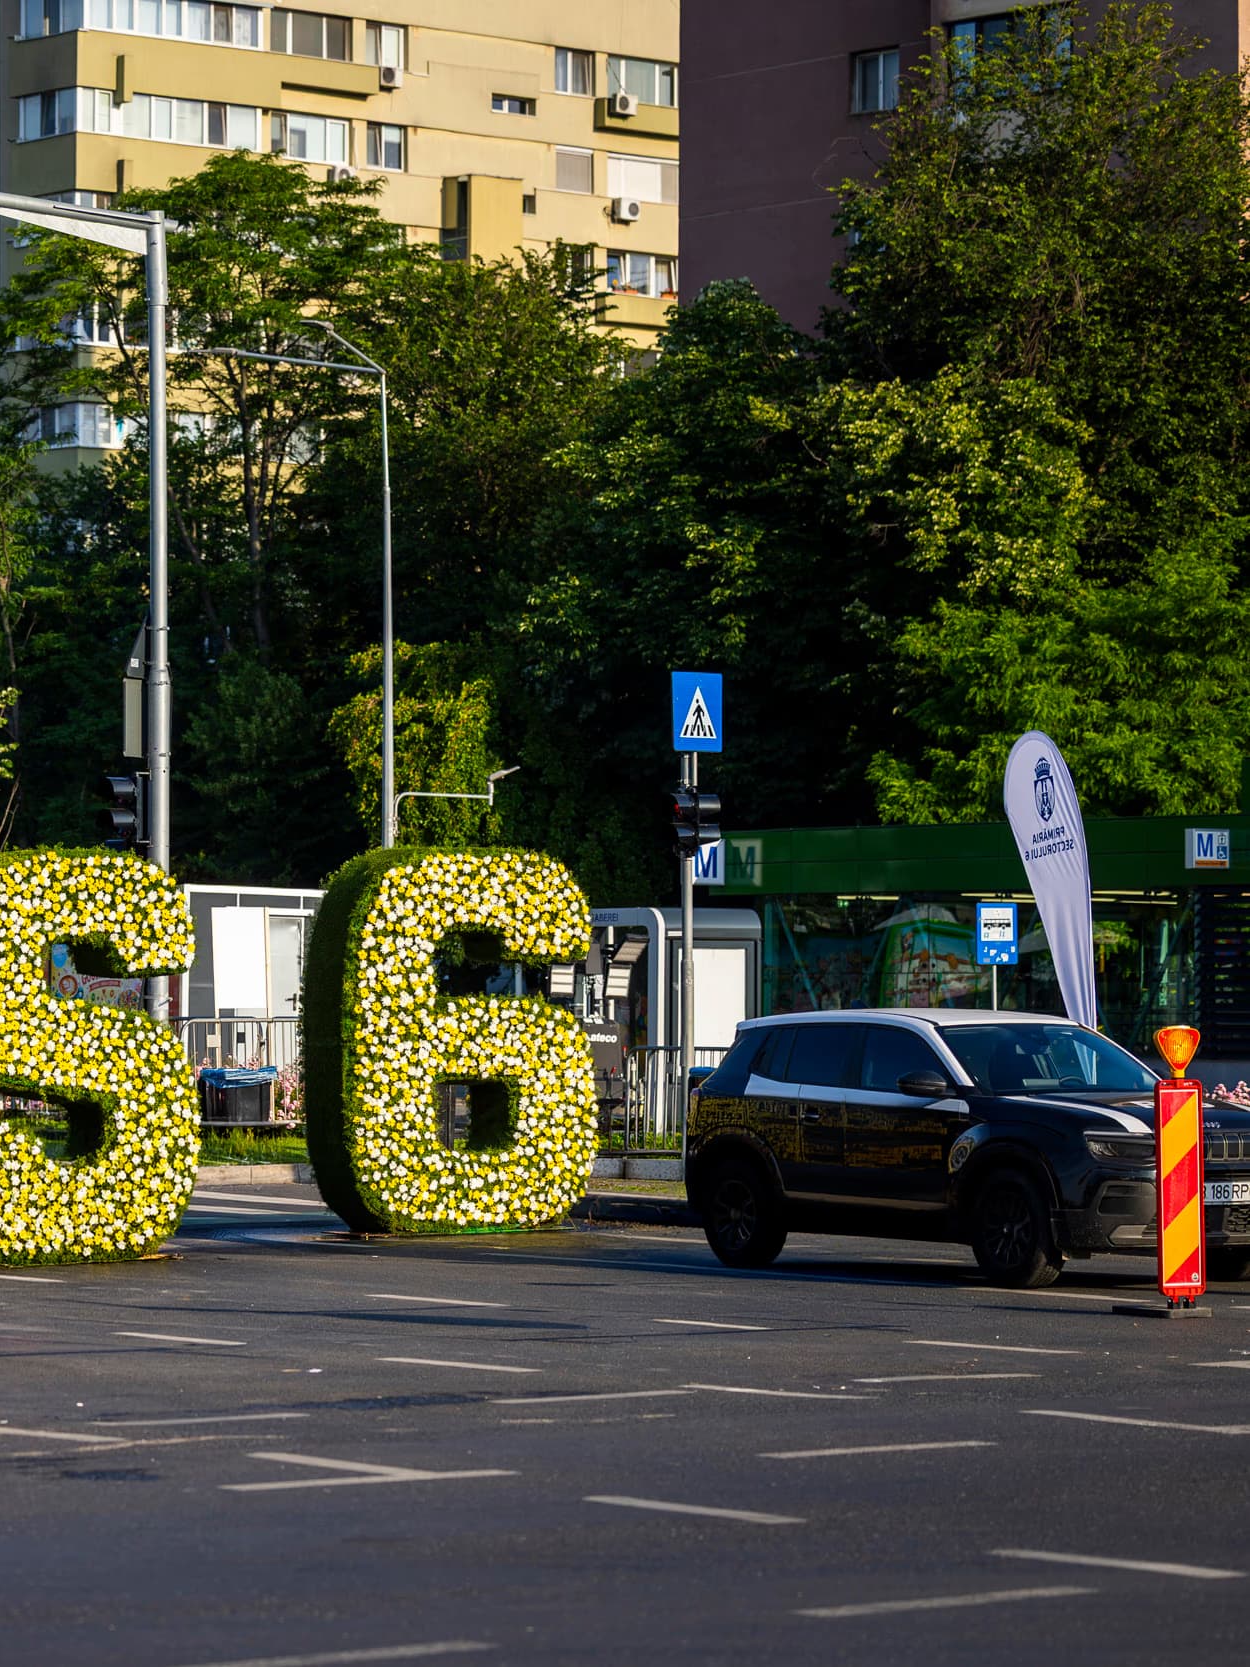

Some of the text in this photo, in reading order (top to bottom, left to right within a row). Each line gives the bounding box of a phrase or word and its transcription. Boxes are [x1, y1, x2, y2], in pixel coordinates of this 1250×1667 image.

[1197, 833, 1213, 857] M
[694, 847, 717, 878] M
[1211, 1184, 1230, 1200] 186
